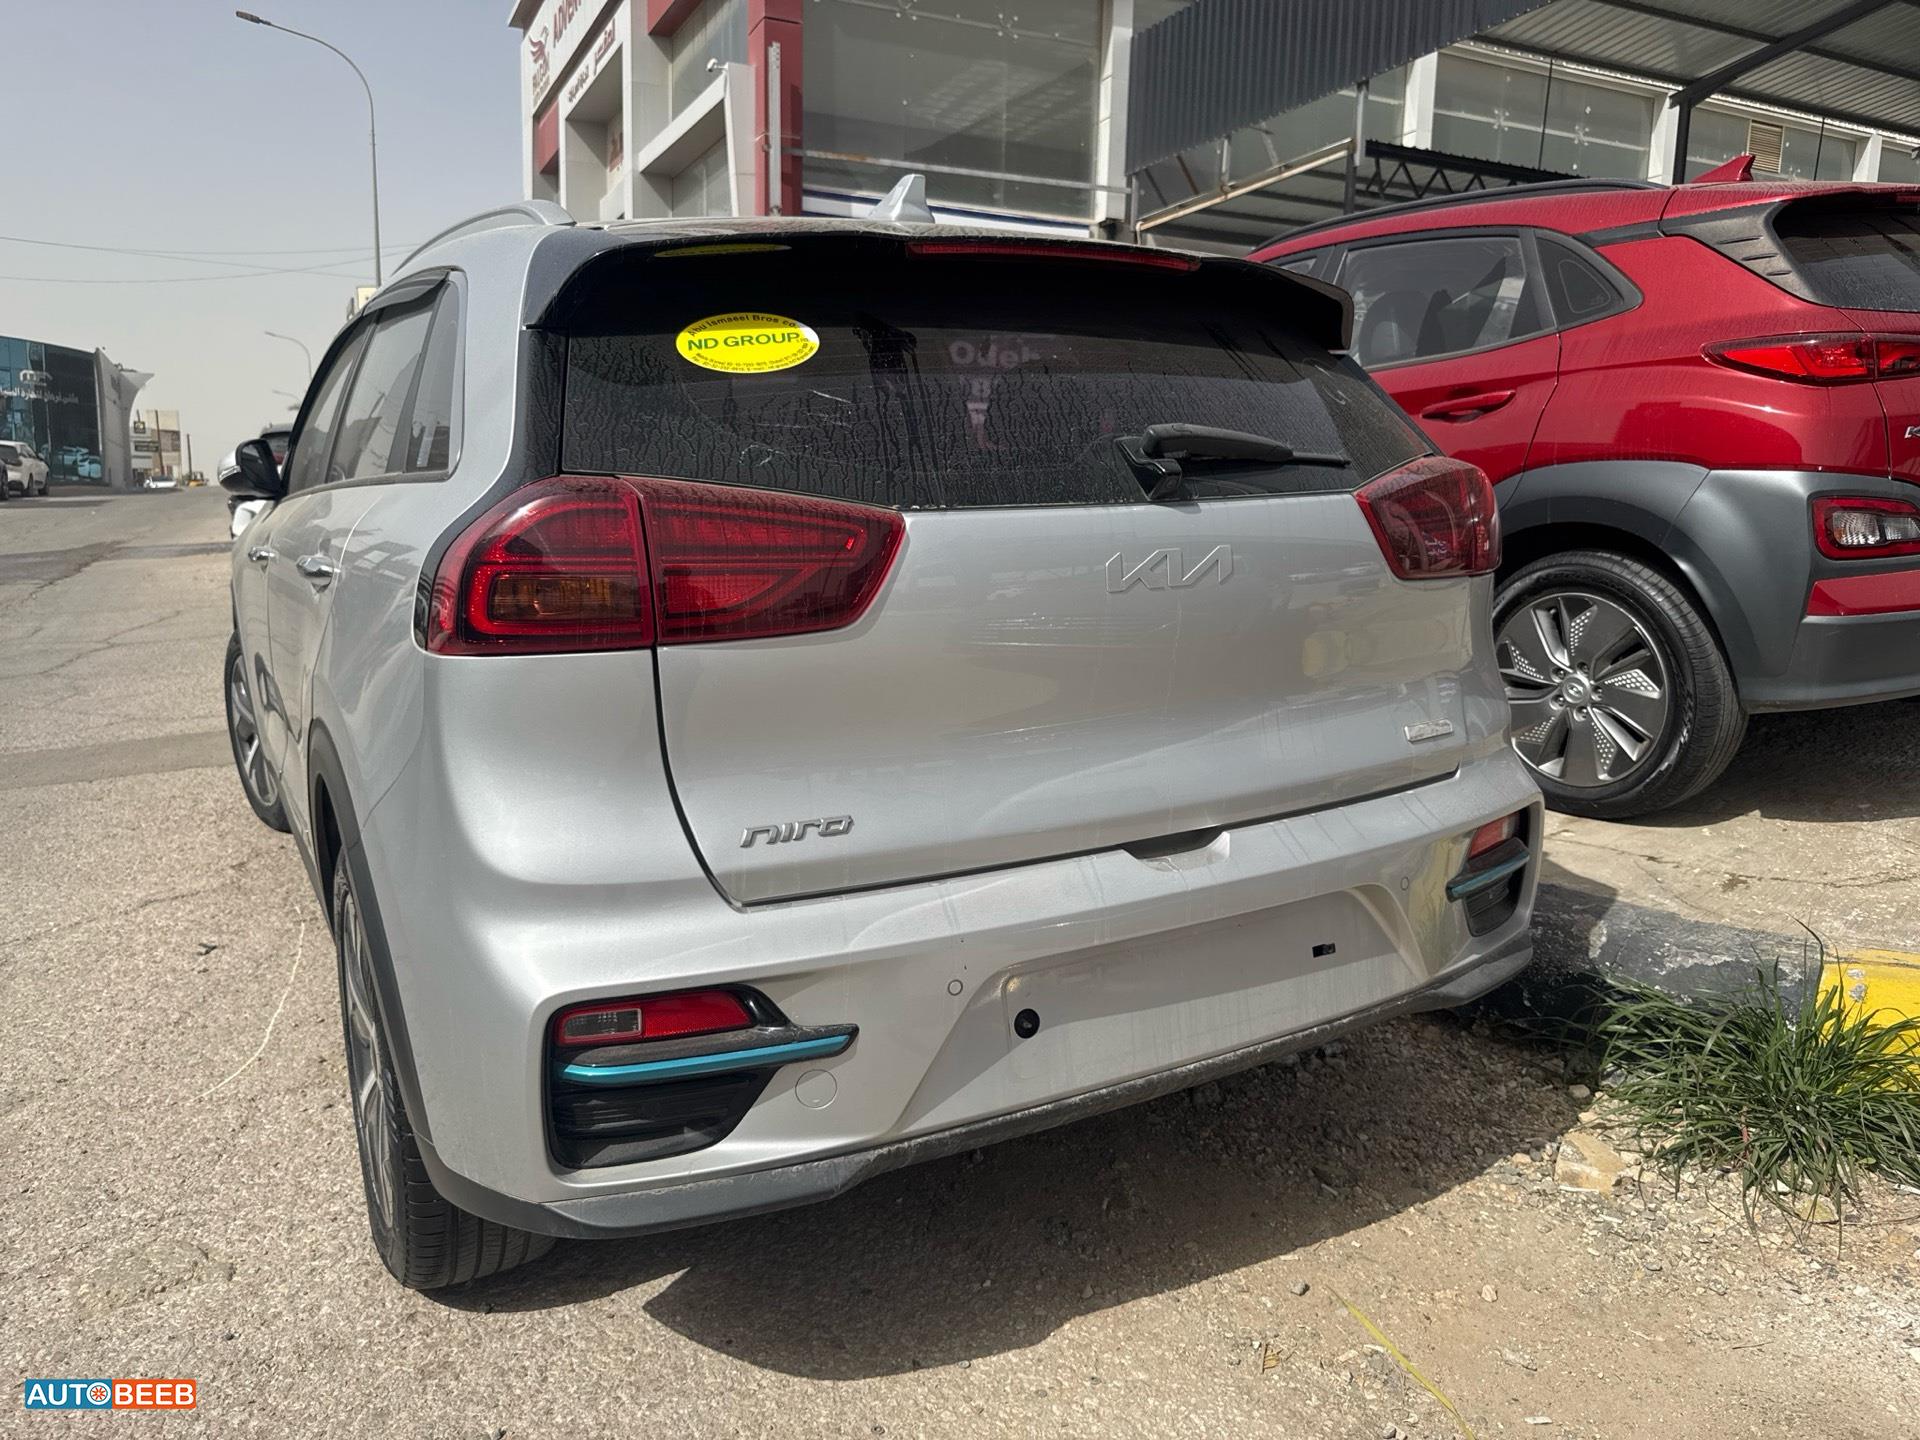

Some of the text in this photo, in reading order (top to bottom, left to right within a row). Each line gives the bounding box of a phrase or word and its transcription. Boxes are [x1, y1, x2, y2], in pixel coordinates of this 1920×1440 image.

[687, 324, 707, 338] Abu
[752, 314, 779, 325] Bros
[687, 337, 719, 351] ND
[723, 332, 800, 347] GROUP
[1105, 544, 1233, 593] KIA
